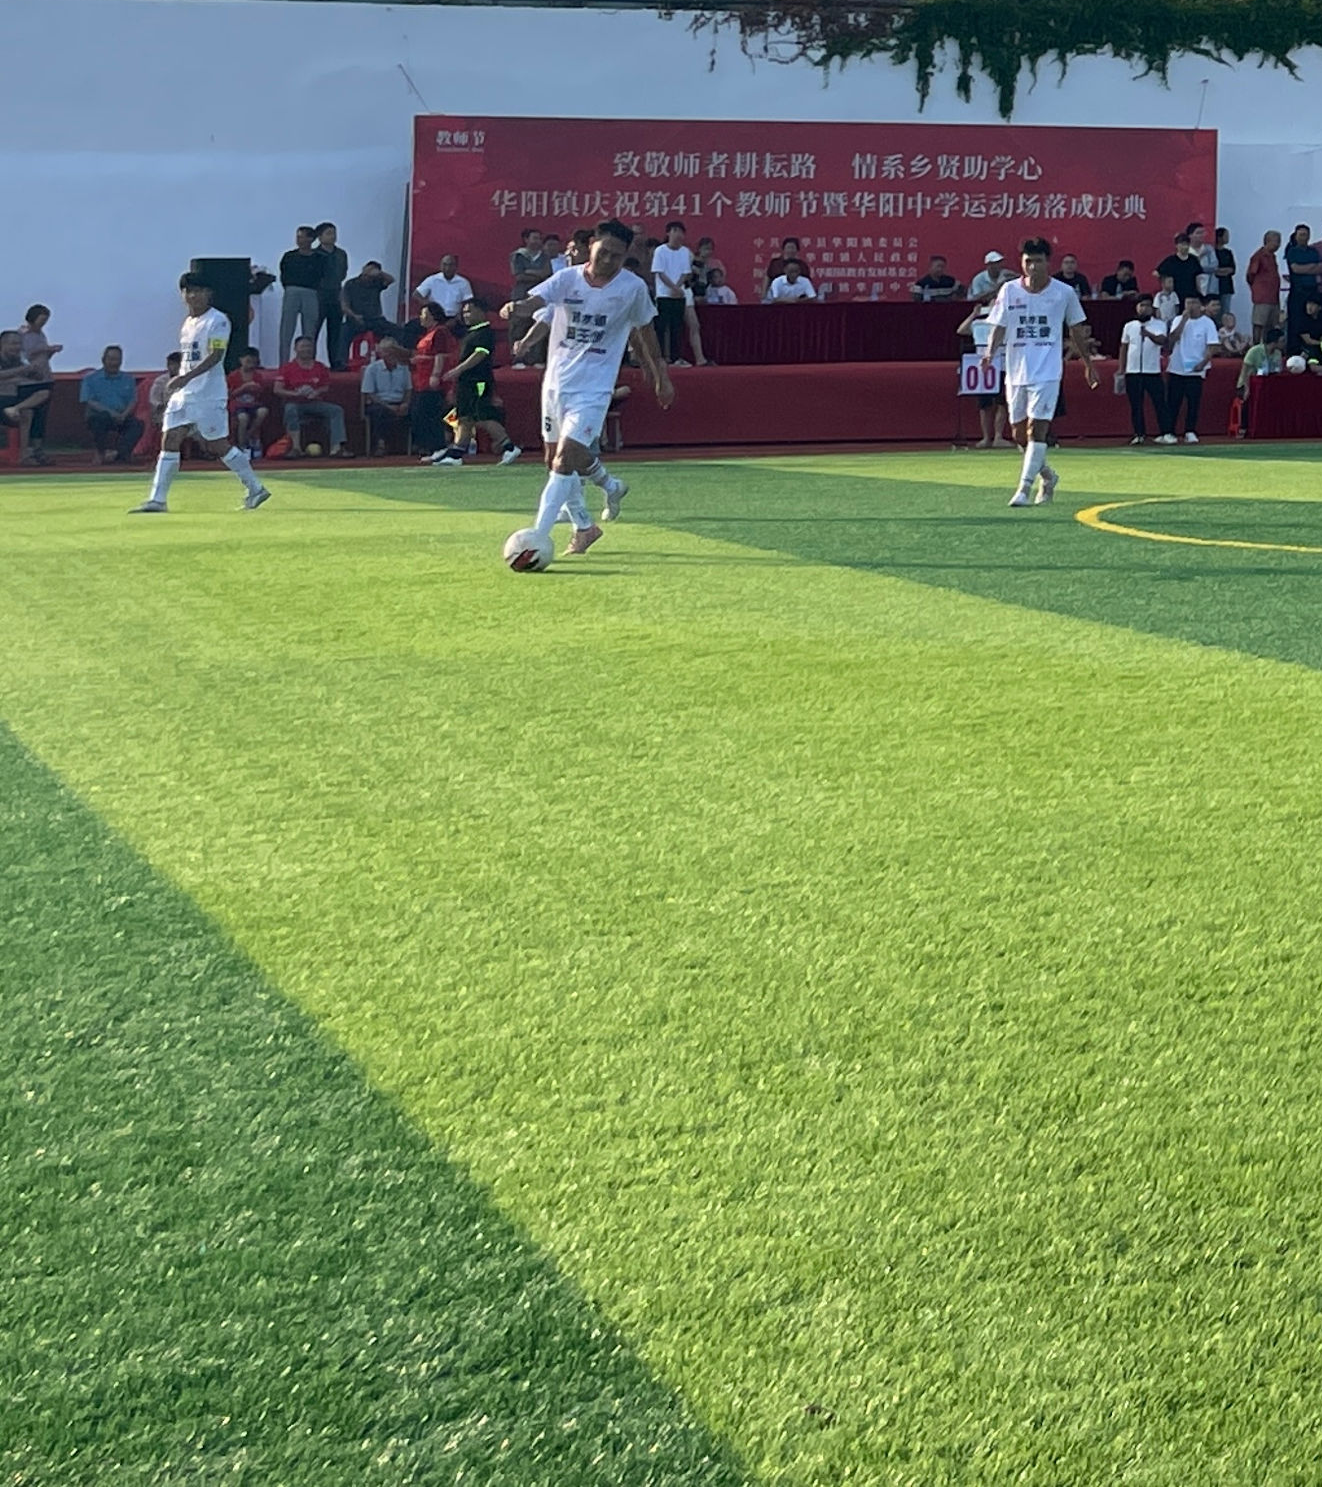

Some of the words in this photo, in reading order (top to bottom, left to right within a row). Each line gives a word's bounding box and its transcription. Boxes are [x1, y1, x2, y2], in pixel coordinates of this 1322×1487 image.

[436, 130, 486, 146] 教师节
[612, 150, 817, 179] 致敬师者耕耘路
[851, 152, 1043, 181] 情系乡贤助学心
[489, 189, 1147, 220] 华阳镇庆祝第41个教师节暨华阳中学运动场落成庆典
